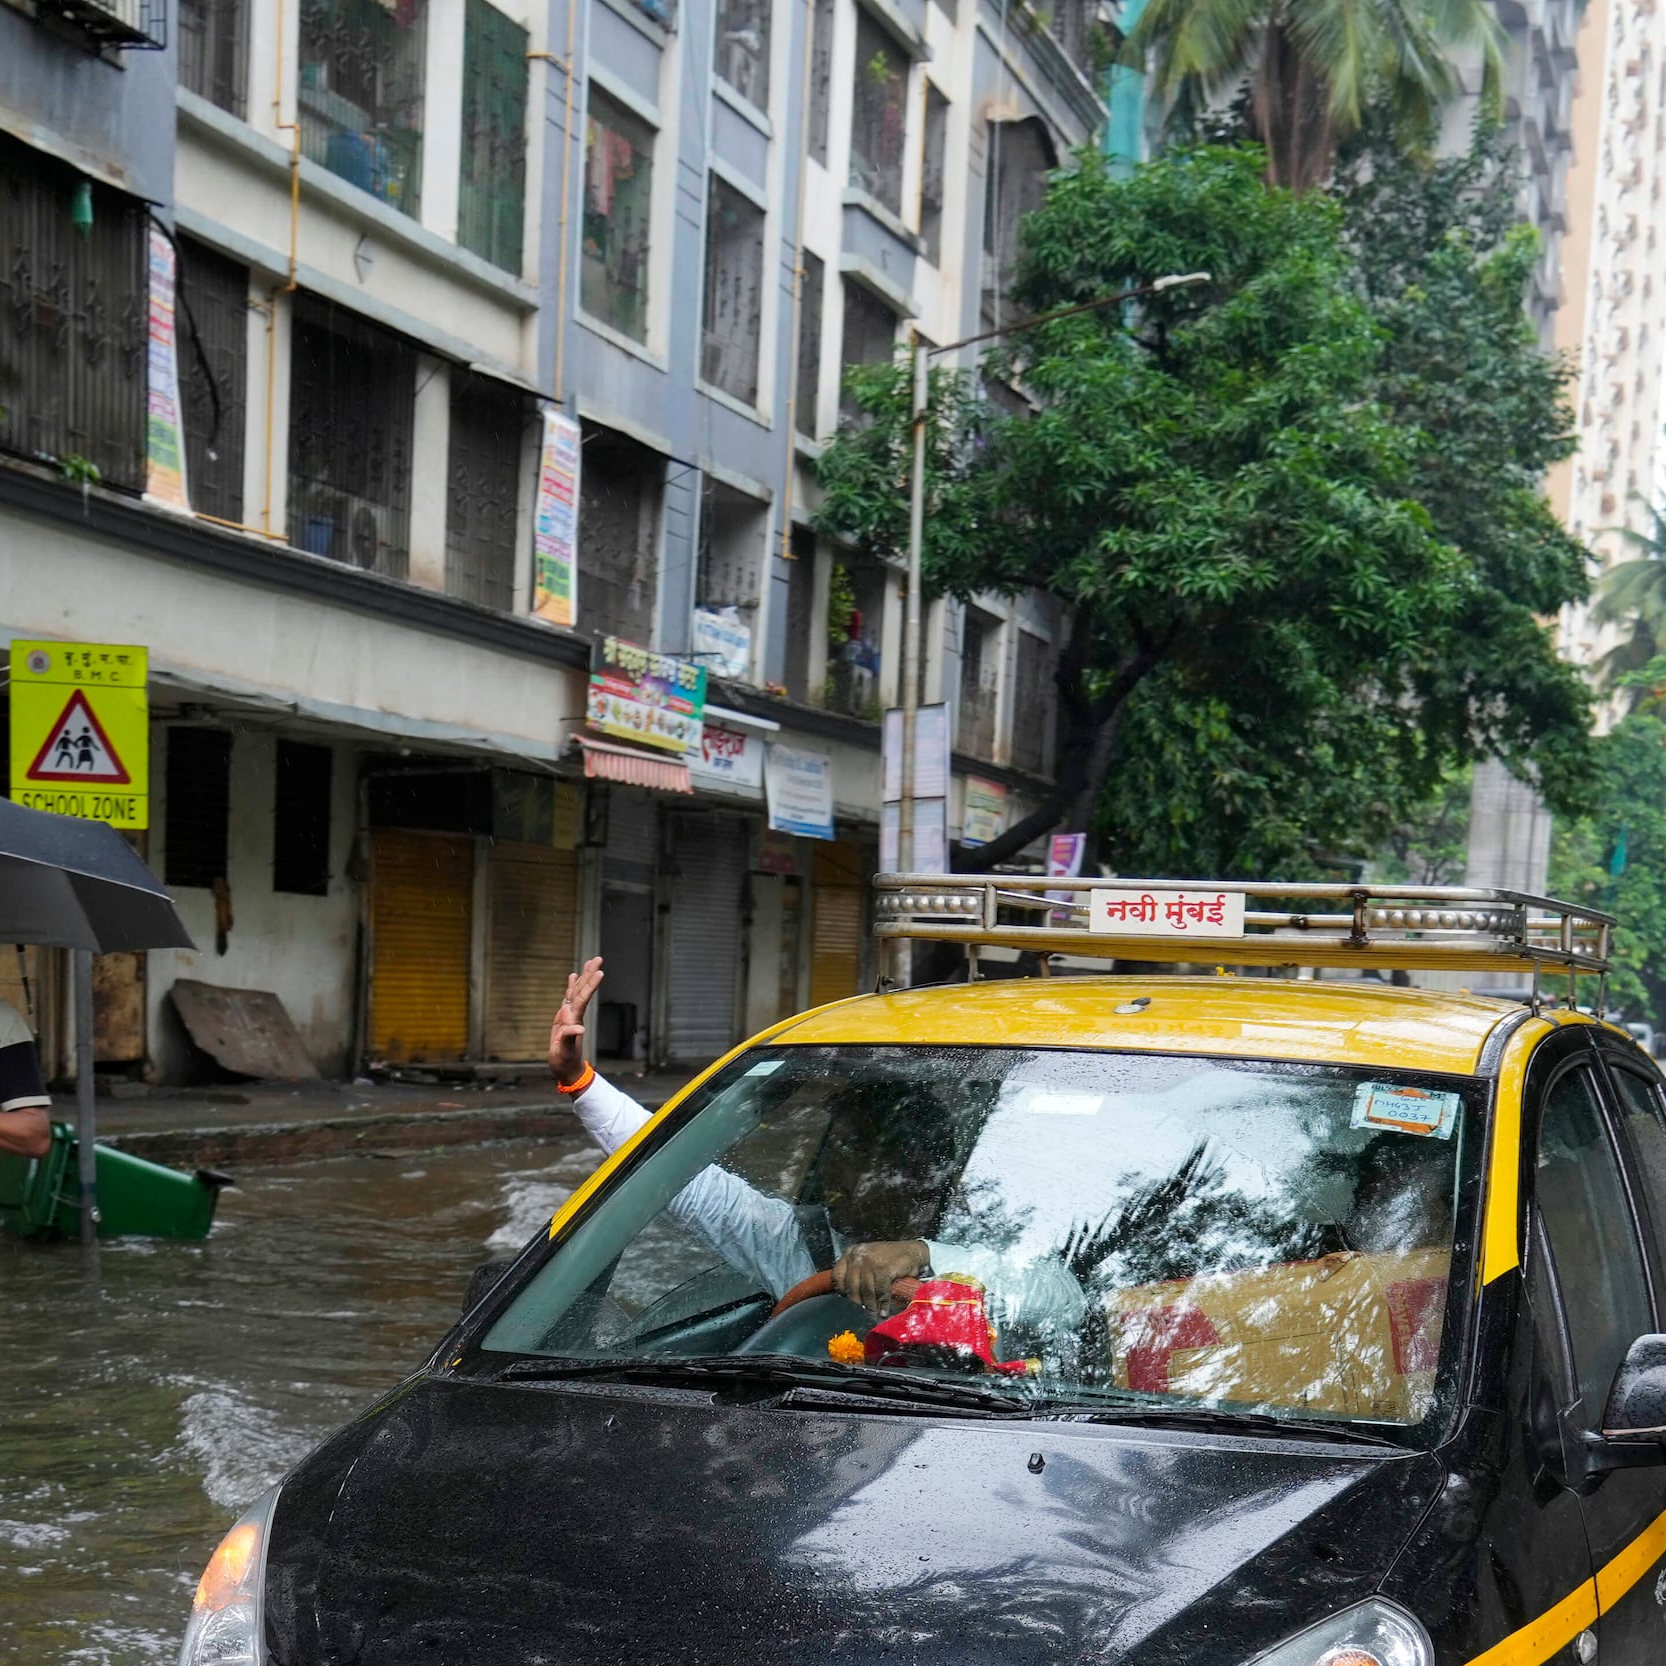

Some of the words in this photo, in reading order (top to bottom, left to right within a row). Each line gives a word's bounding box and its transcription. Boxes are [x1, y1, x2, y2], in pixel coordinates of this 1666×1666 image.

[93, 797, 137, 820] ZONE
[1106, 894, 1158, 922] नवी
[1165, 894, 1226, 930] मुंबई
[1388, 1110, 1430, 1121] 0037
